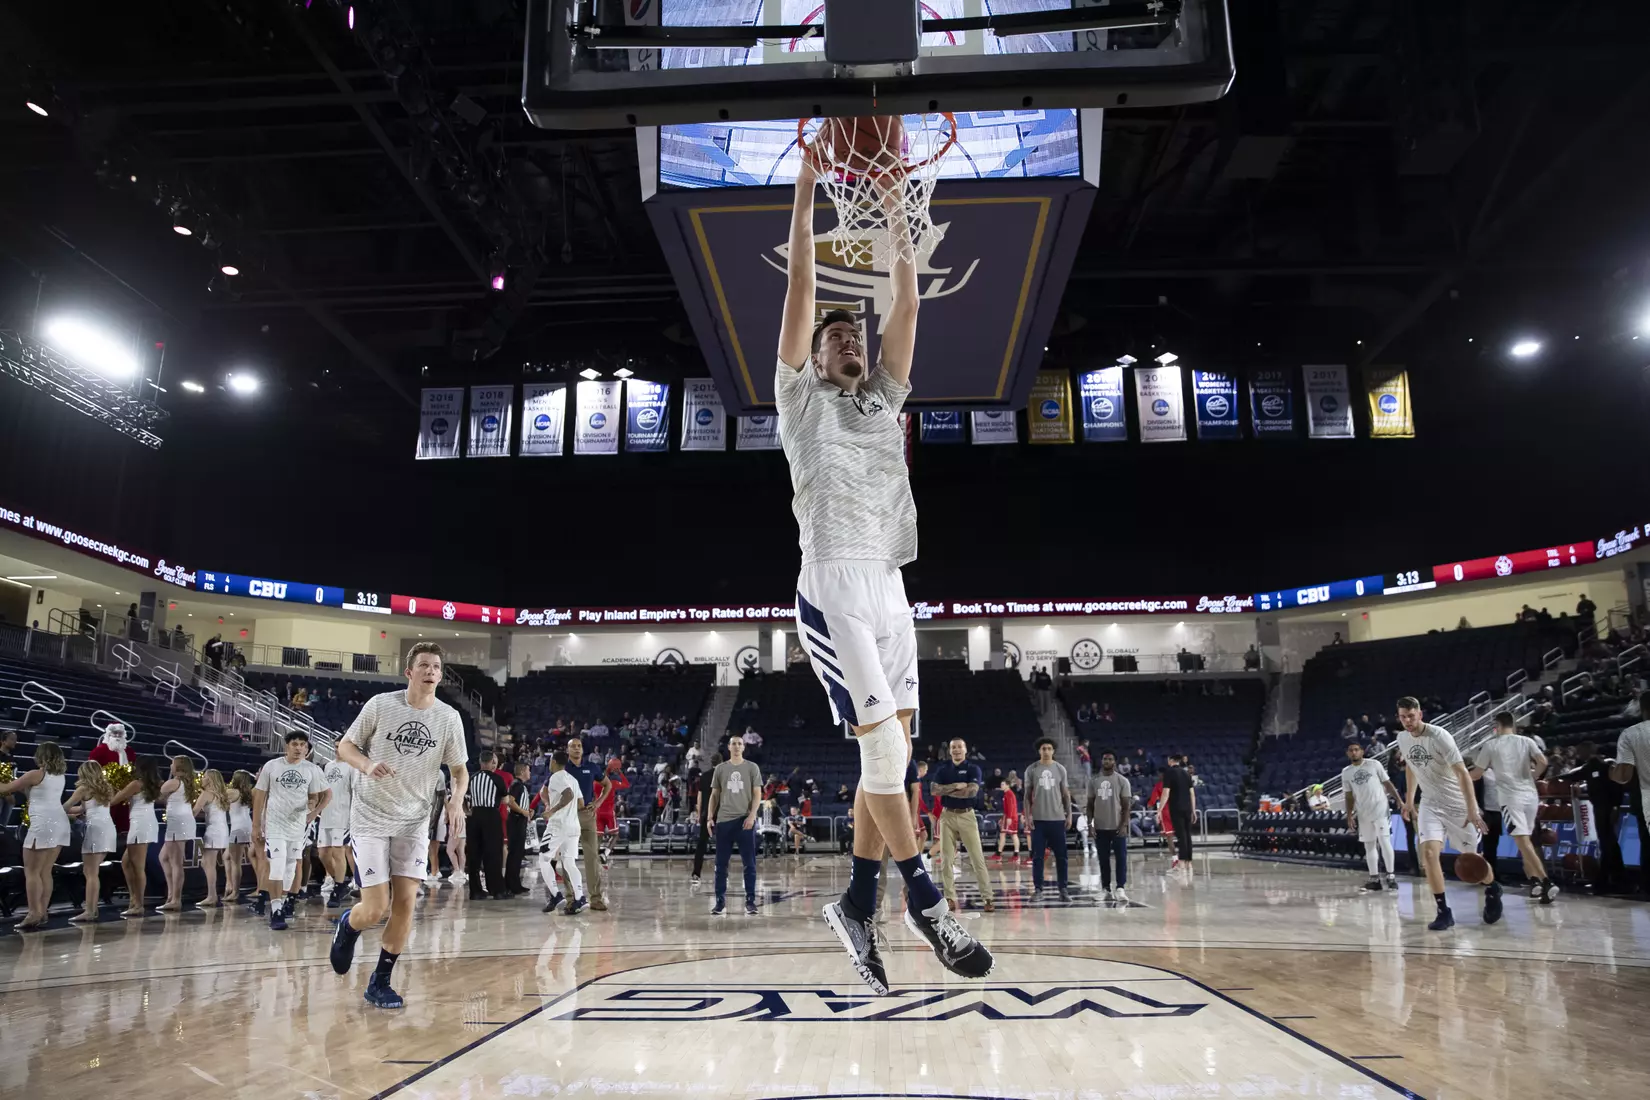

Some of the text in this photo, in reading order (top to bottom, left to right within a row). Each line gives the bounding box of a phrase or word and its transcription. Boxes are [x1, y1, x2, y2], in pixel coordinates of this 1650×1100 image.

[1312, 371, 1337, 379] 2017
[22, 516, 34, 528] at
[36, 520, 149, 569] www.goosecreekgc.com
[1596, 538, 1618, 559] Goose
[1615, 526, 1640, 545] Creek
[1606, 542, 1632, 557] GOLF CLUB
[154, 559, 196, 584] Goose Creek
[1396, 571, 1419, 586] 3:13
[1454, 564, 1464, 581] 0
[164, 574, 187, 587] GOLF CLUB
[1356, 580, 1364, 596] 0
[249, 580, 288, 599] CBU
[316, 587, 324, 603] 0
[1297, 586, 1330, 605] CBU
[357, 592, 378, 606] 3:13
[408, 599, 416, 614] 0
[953, 600, 1187, 614] Book Tee Times at www.goosecreekgc.com
[1196, 595, 1254, 612] Goose Creek
[516, 609, 572, 624] Goose Creek
[579, 610, 602, 622] Play
[604, 610, 637, 620] Inland
[639, 609, 686, 621] Empire's
[688, 609, 710, 620] Top
[712, 608, 744, 618] Rated
[746, 607, 770, 618] Golf
[386, 732, 438, 748] LANCERS
[1580, 804, 1589, 836] Wilson
[550, 987, 1209, 1021] WAC
